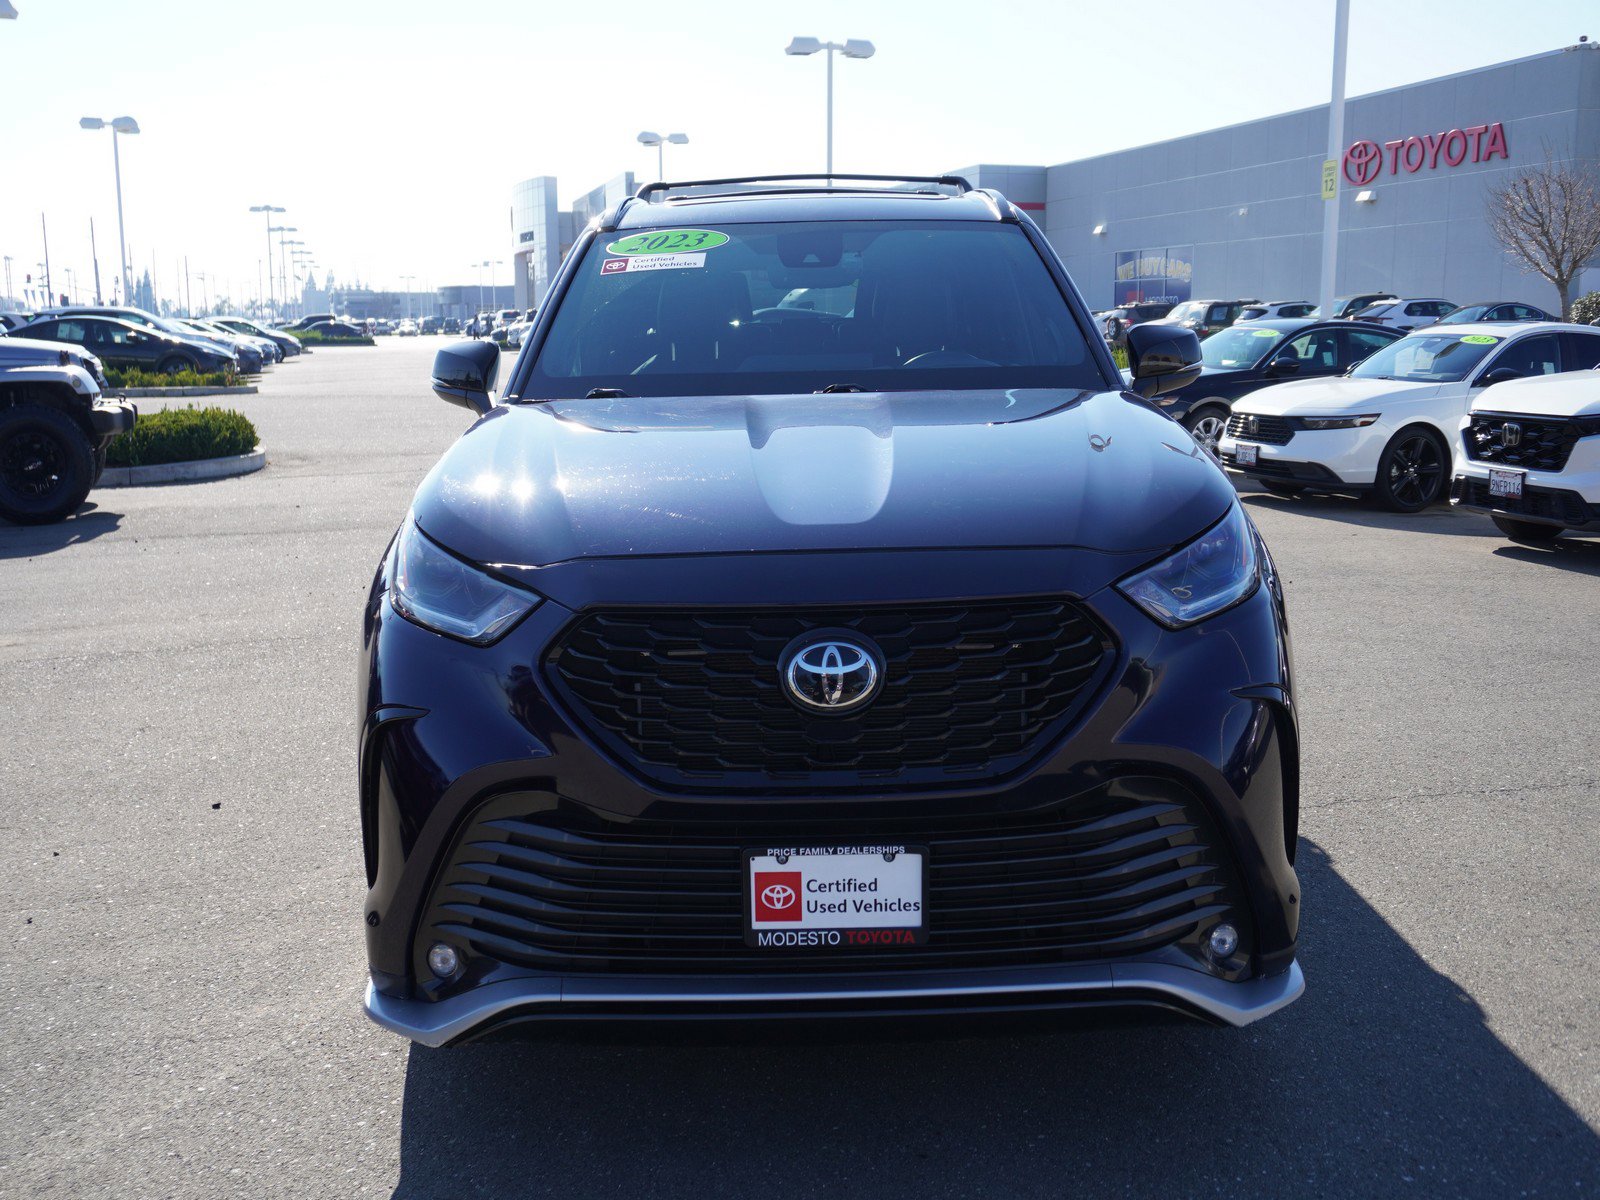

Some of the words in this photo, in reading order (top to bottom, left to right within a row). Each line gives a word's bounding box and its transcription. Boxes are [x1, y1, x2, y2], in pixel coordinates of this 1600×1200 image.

[1385, 122, 1509, 175] TOYOTA
[1324, 178, 1335, 192] 12
[624, 232, 709, 252] 2023
[1117, 260, 1135, 283] WE
[1136, 257, 1161, 277] BUY
[1159, 257, 1192, 283] CARS
[767, 848, 797, 857] PRICE
[800, 847, 834, 856] FAMILY
[837, 846, 906, 855] DEALERSHIPS
[806, 878, 878, 893] Certified
[806, 899, 847, 914] Used
[853, 898, 920, 913] Vehicles
[758, 931, 841, 946] MODESTO
[845, 930, 916, 944] TOYOTA
